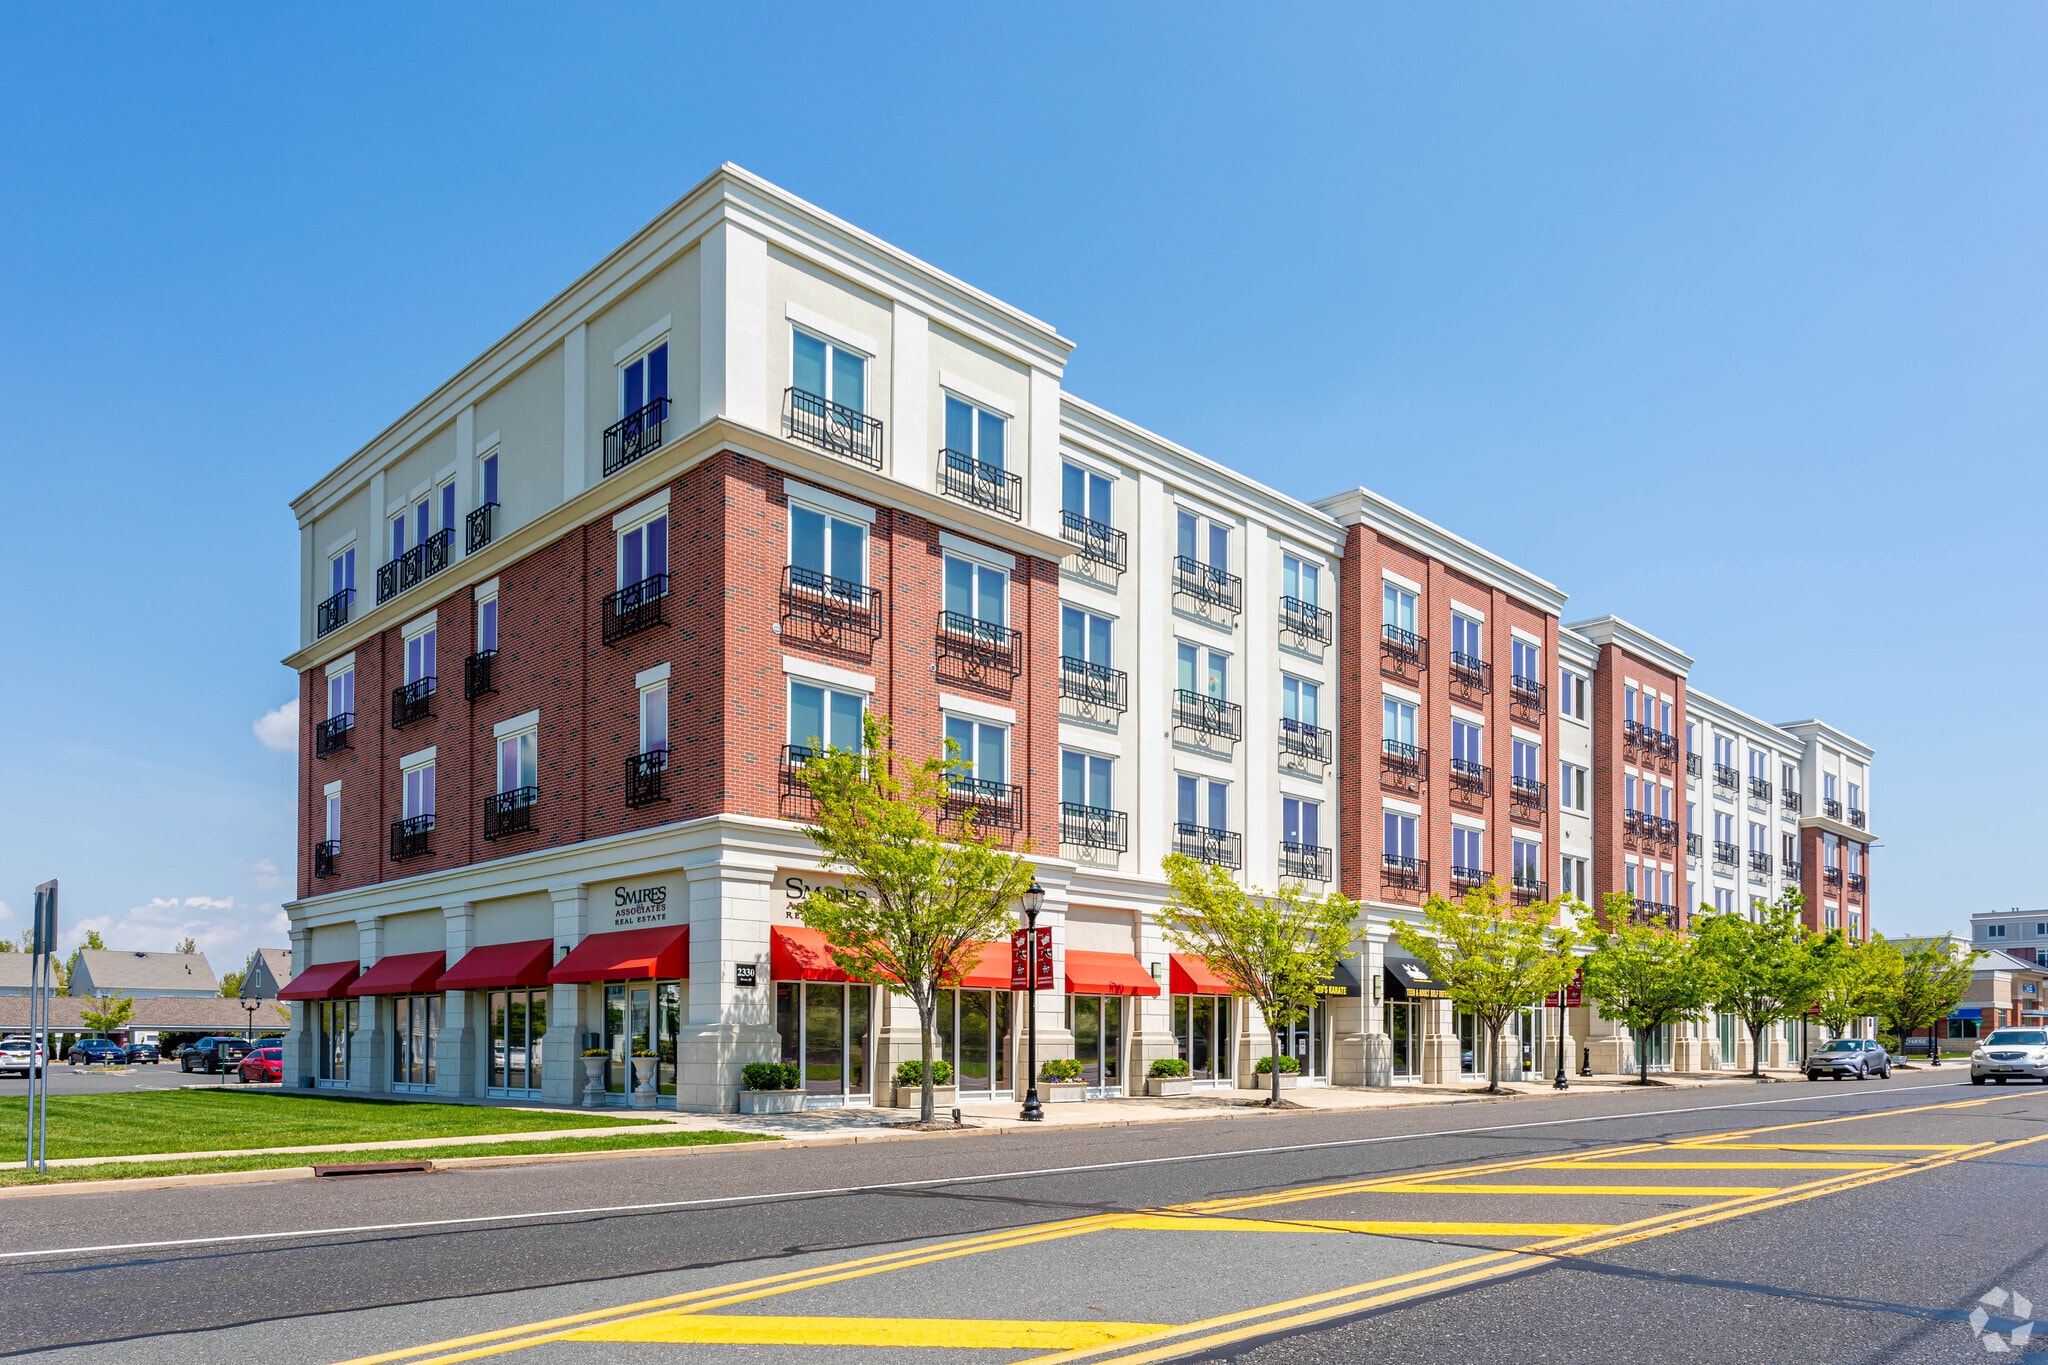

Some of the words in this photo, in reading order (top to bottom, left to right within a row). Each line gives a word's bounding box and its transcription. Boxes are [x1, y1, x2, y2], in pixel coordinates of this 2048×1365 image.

[615, 886, 667, 906] SMIRES
[615, 904, 666, 917] ASSOCIATES
[615, 918, 634, 926] REAL
[637, 914, 666, 923] ESTATE
[737, 967, 755, 977] 2330
[1329, 986, 1347, 995] KARATE
